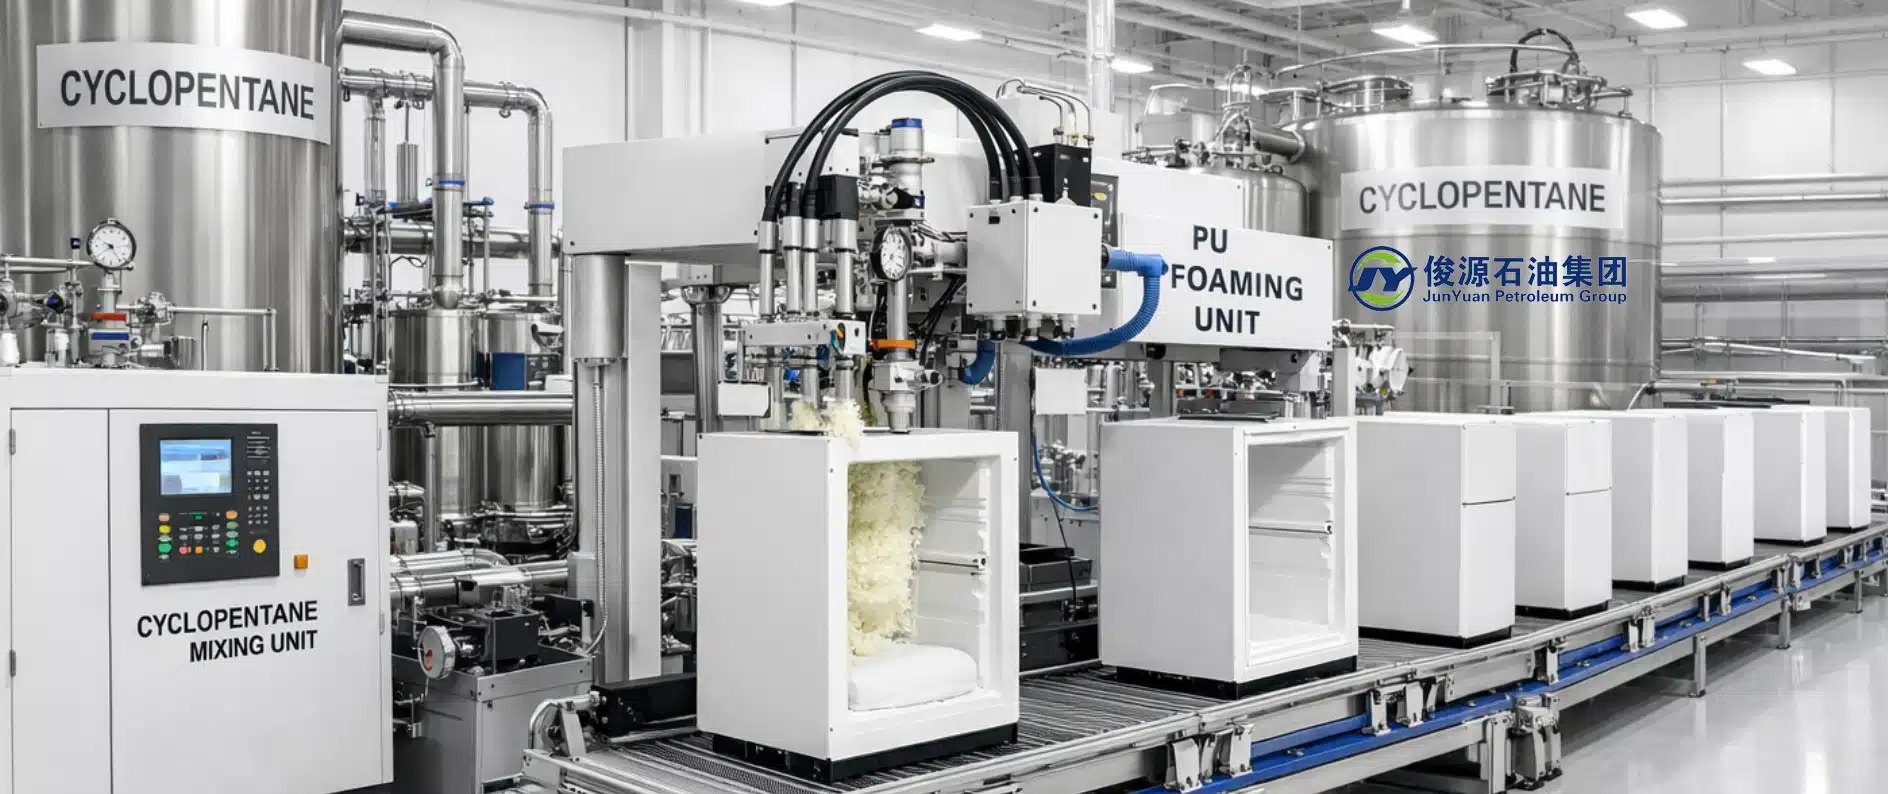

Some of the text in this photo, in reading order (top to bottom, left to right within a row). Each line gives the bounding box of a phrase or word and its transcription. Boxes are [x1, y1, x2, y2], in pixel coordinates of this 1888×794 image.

[60, 68, 315, 121] CYCLOPENTANE
[1359, 180, 1606, 214] CYCLOPENTANE
[1193, 225, 1228, 254] PU
[1171, 264, 1303, 301] FOAMING
[1195, 306, 1260, 335] UNIT
[137, 600, 318, 638] CYCLOPENTANE
[190, 630, 318, 663] MIXING UNIT
